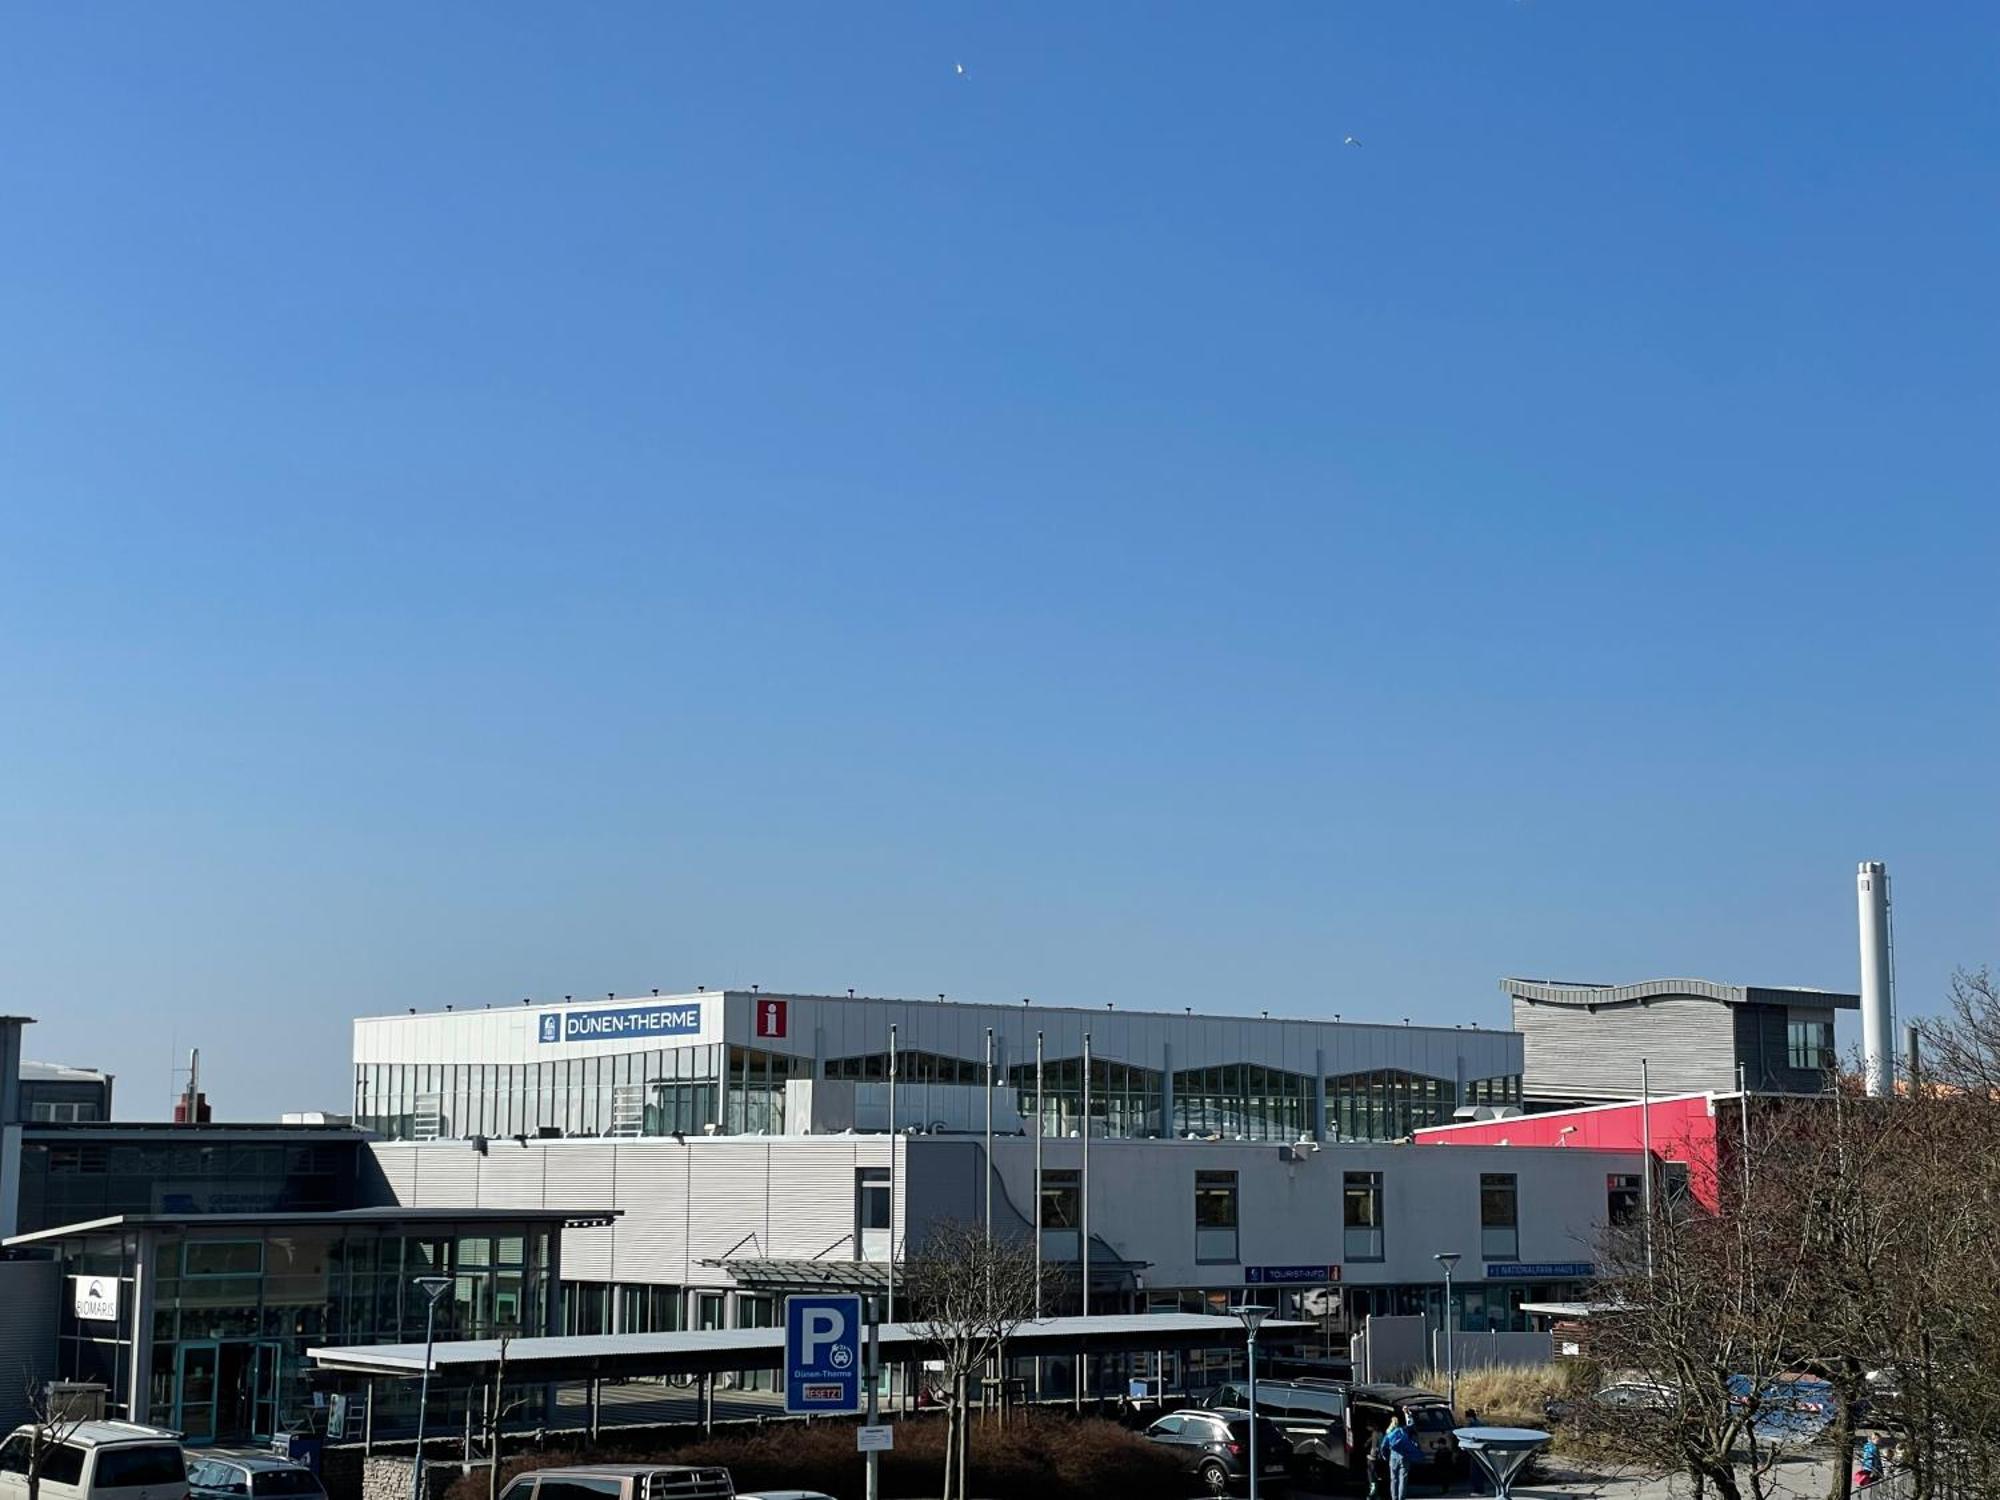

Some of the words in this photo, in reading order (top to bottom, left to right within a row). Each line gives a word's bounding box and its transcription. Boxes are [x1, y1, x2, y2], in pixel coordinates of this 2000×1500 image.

[567, 1010, 698, 1035] DÜNEN-THERME
[76, 1300, 115, 1317] BIOMARIS
[801, 1307, 845, 1366] P
[793, 1370, 852, 1378] Dünen-Therme
